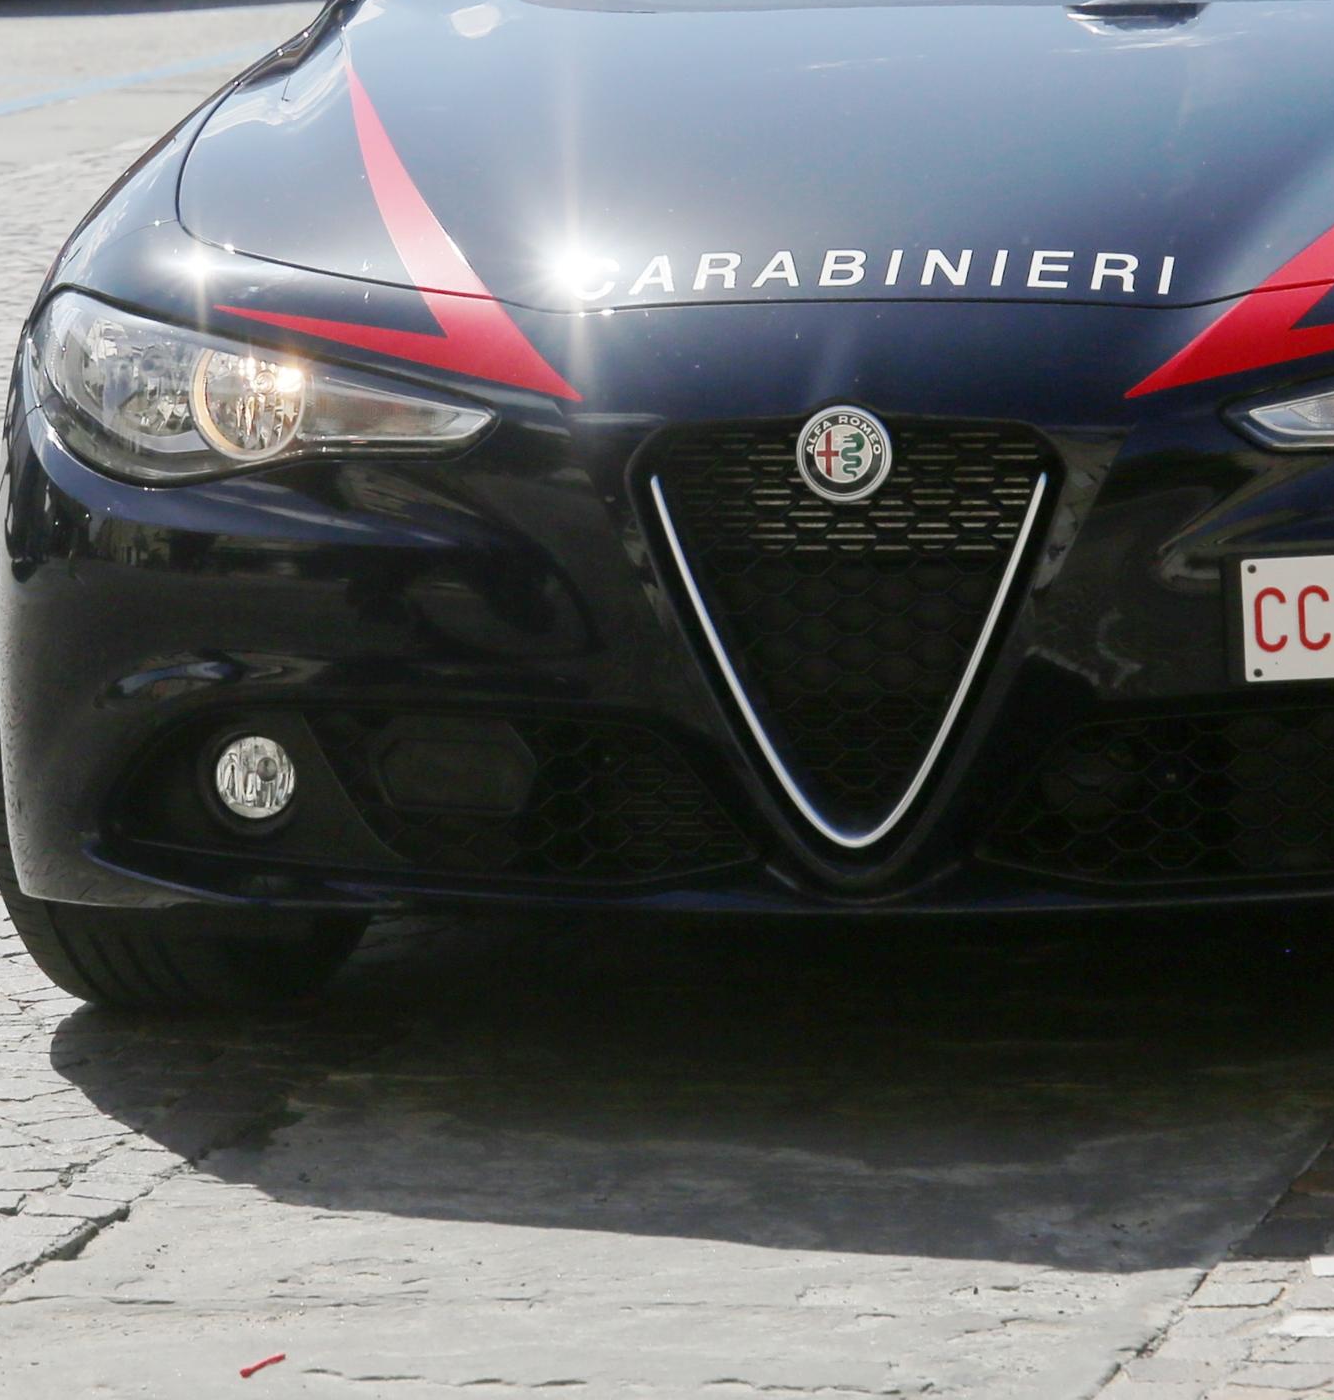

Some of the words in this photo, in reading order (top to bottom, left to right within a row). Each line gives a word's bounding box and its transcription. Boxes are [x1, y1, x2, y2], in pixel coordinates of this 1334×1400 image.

[565, 249, 1175, 300] CARABINIERI
[806, 420, 832, 455] ALFA
[838, 415, 882, 455] ROMEO
[1253, 585, 1331, 653] CC
